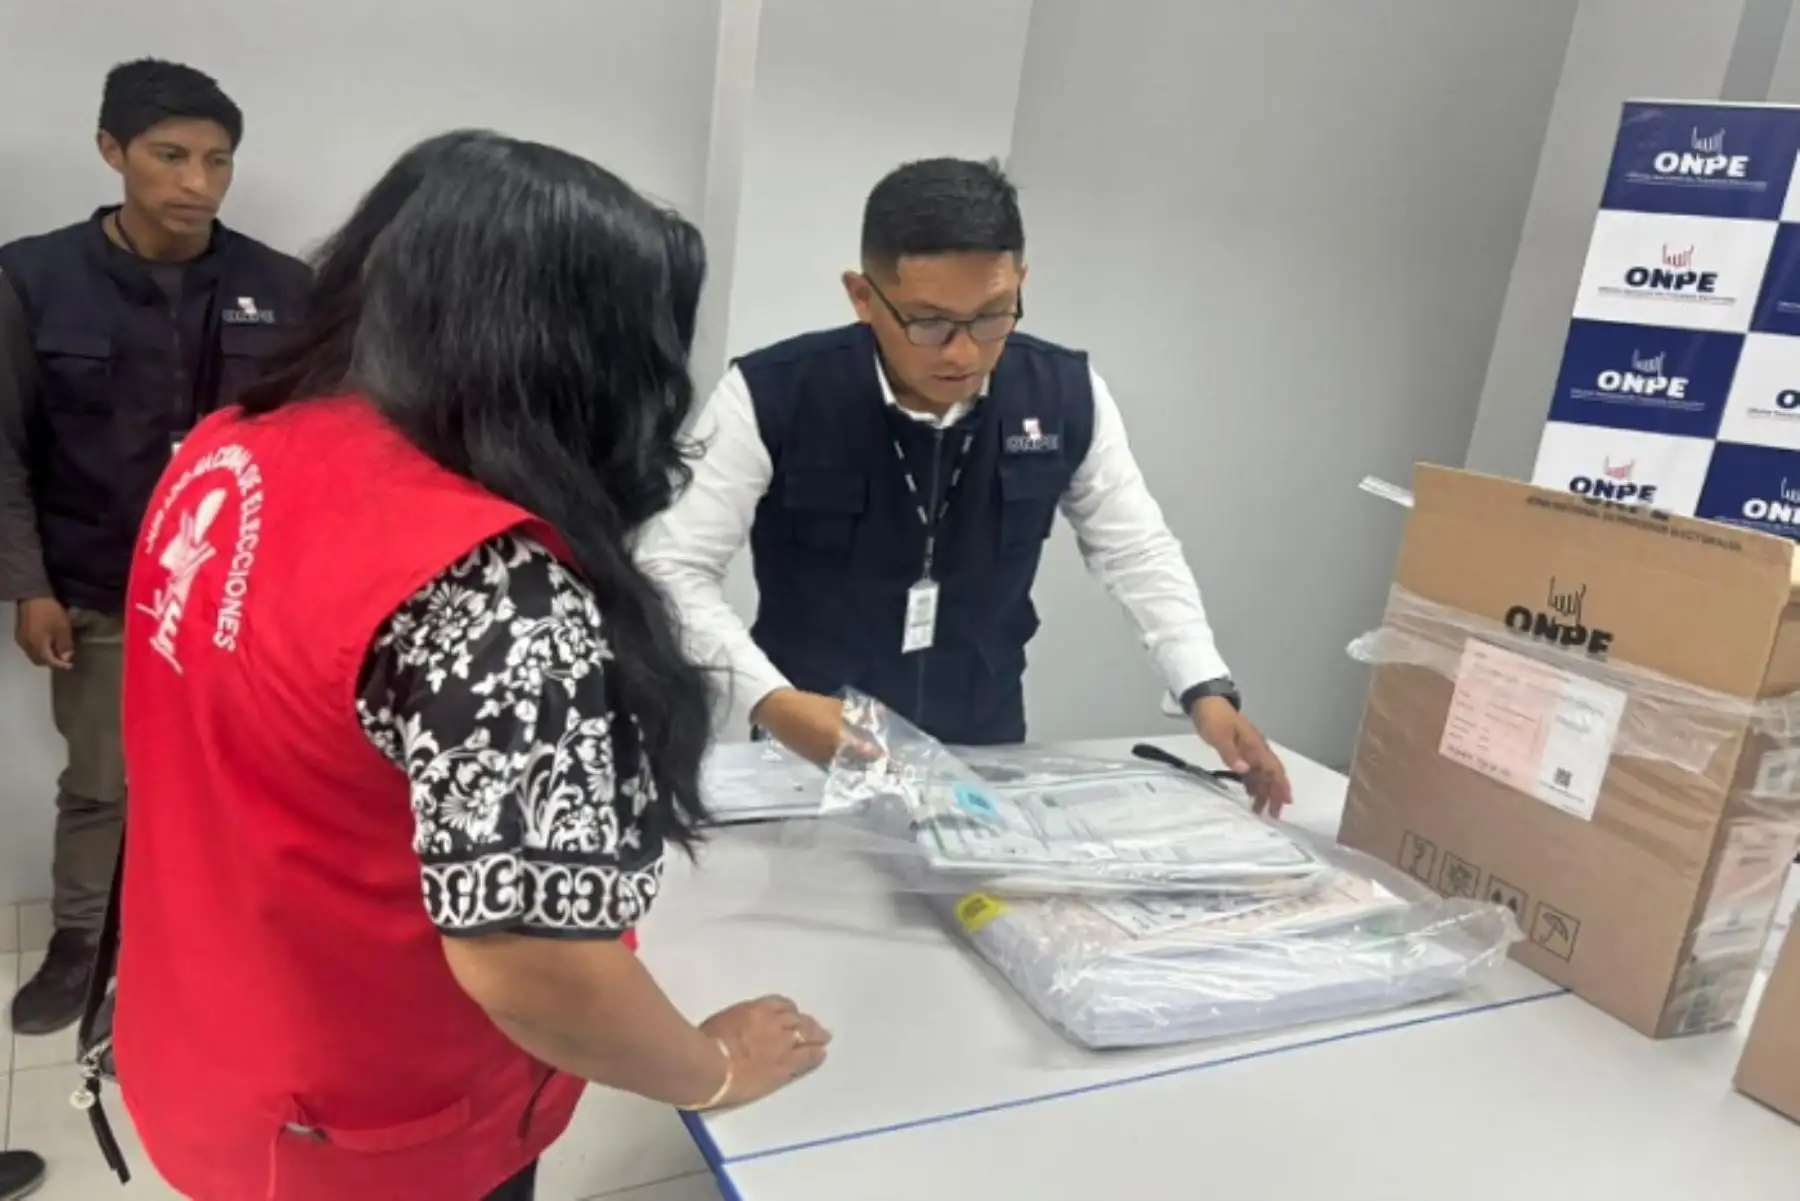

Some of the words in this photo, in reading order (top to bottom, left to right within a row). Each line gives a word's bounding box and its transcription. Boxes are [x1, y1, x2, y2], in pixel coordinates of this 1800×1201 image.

[1653, 151, 1749, 178] ONPE
[1624, 266, 1718, 293] ONPE
[1597, 369, 1689, 399] ONPE
[1776, 389, 1800, 410] O
[1569, 476, 1658, 503] ONPE
[1505, 605, 1614, 662] ONPE
